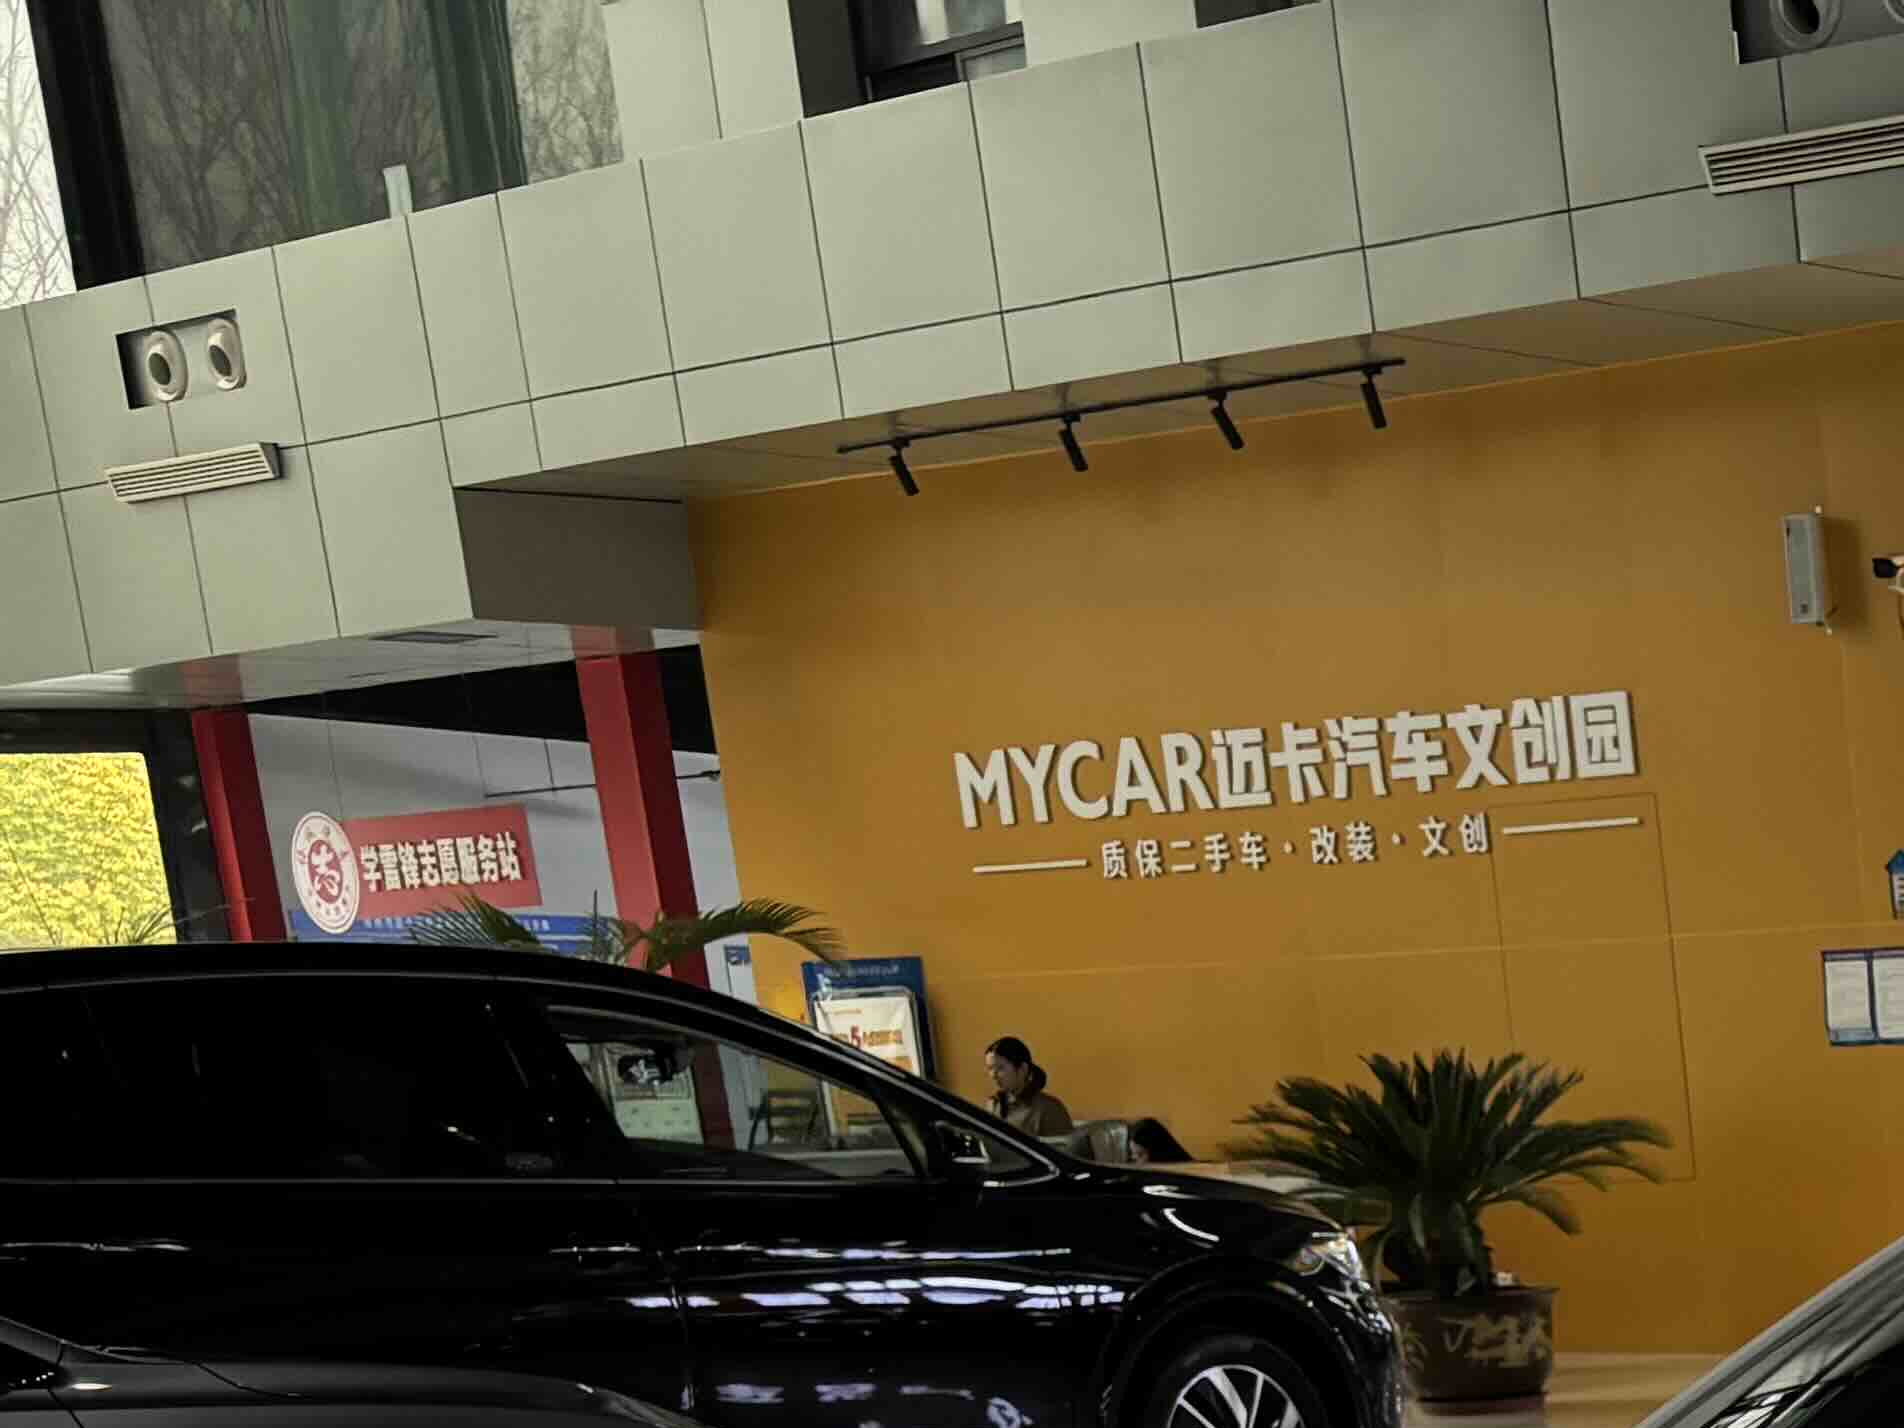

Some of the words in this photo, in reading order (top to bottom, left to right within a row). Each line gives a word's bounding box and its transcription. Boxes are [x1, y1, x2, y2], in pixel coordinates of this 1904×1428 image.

[953, 690, 1638, 829] MYCAR迈卡汽车文创园
[359, 831, 521, 892] 学雷锋志愿服务站
